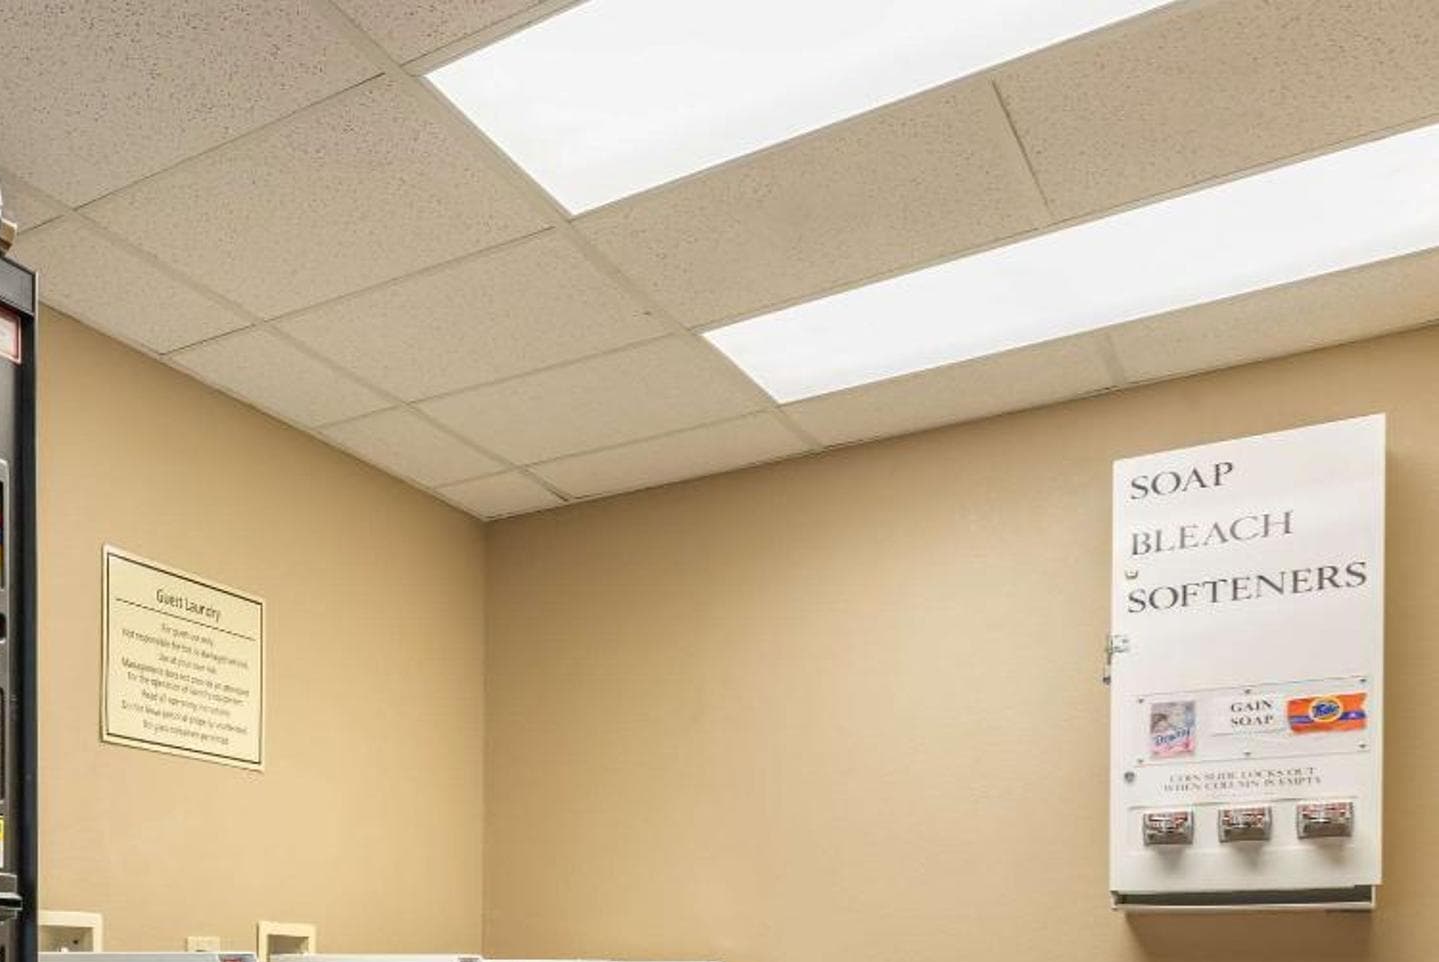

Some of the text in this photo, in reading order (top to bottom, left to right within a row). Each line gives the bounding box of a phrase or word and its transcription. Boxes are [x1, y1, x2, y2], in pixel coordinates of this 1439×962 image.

[1130, 461, 1235, 500] SOAP
[1131, 510, 1295, 556] BLEACH
[1127, 561, 1368, 614] SOFTENERS
[1230, 699, 1273, 713] GAIN
[1230, 714, 1274, 726] SOAP
